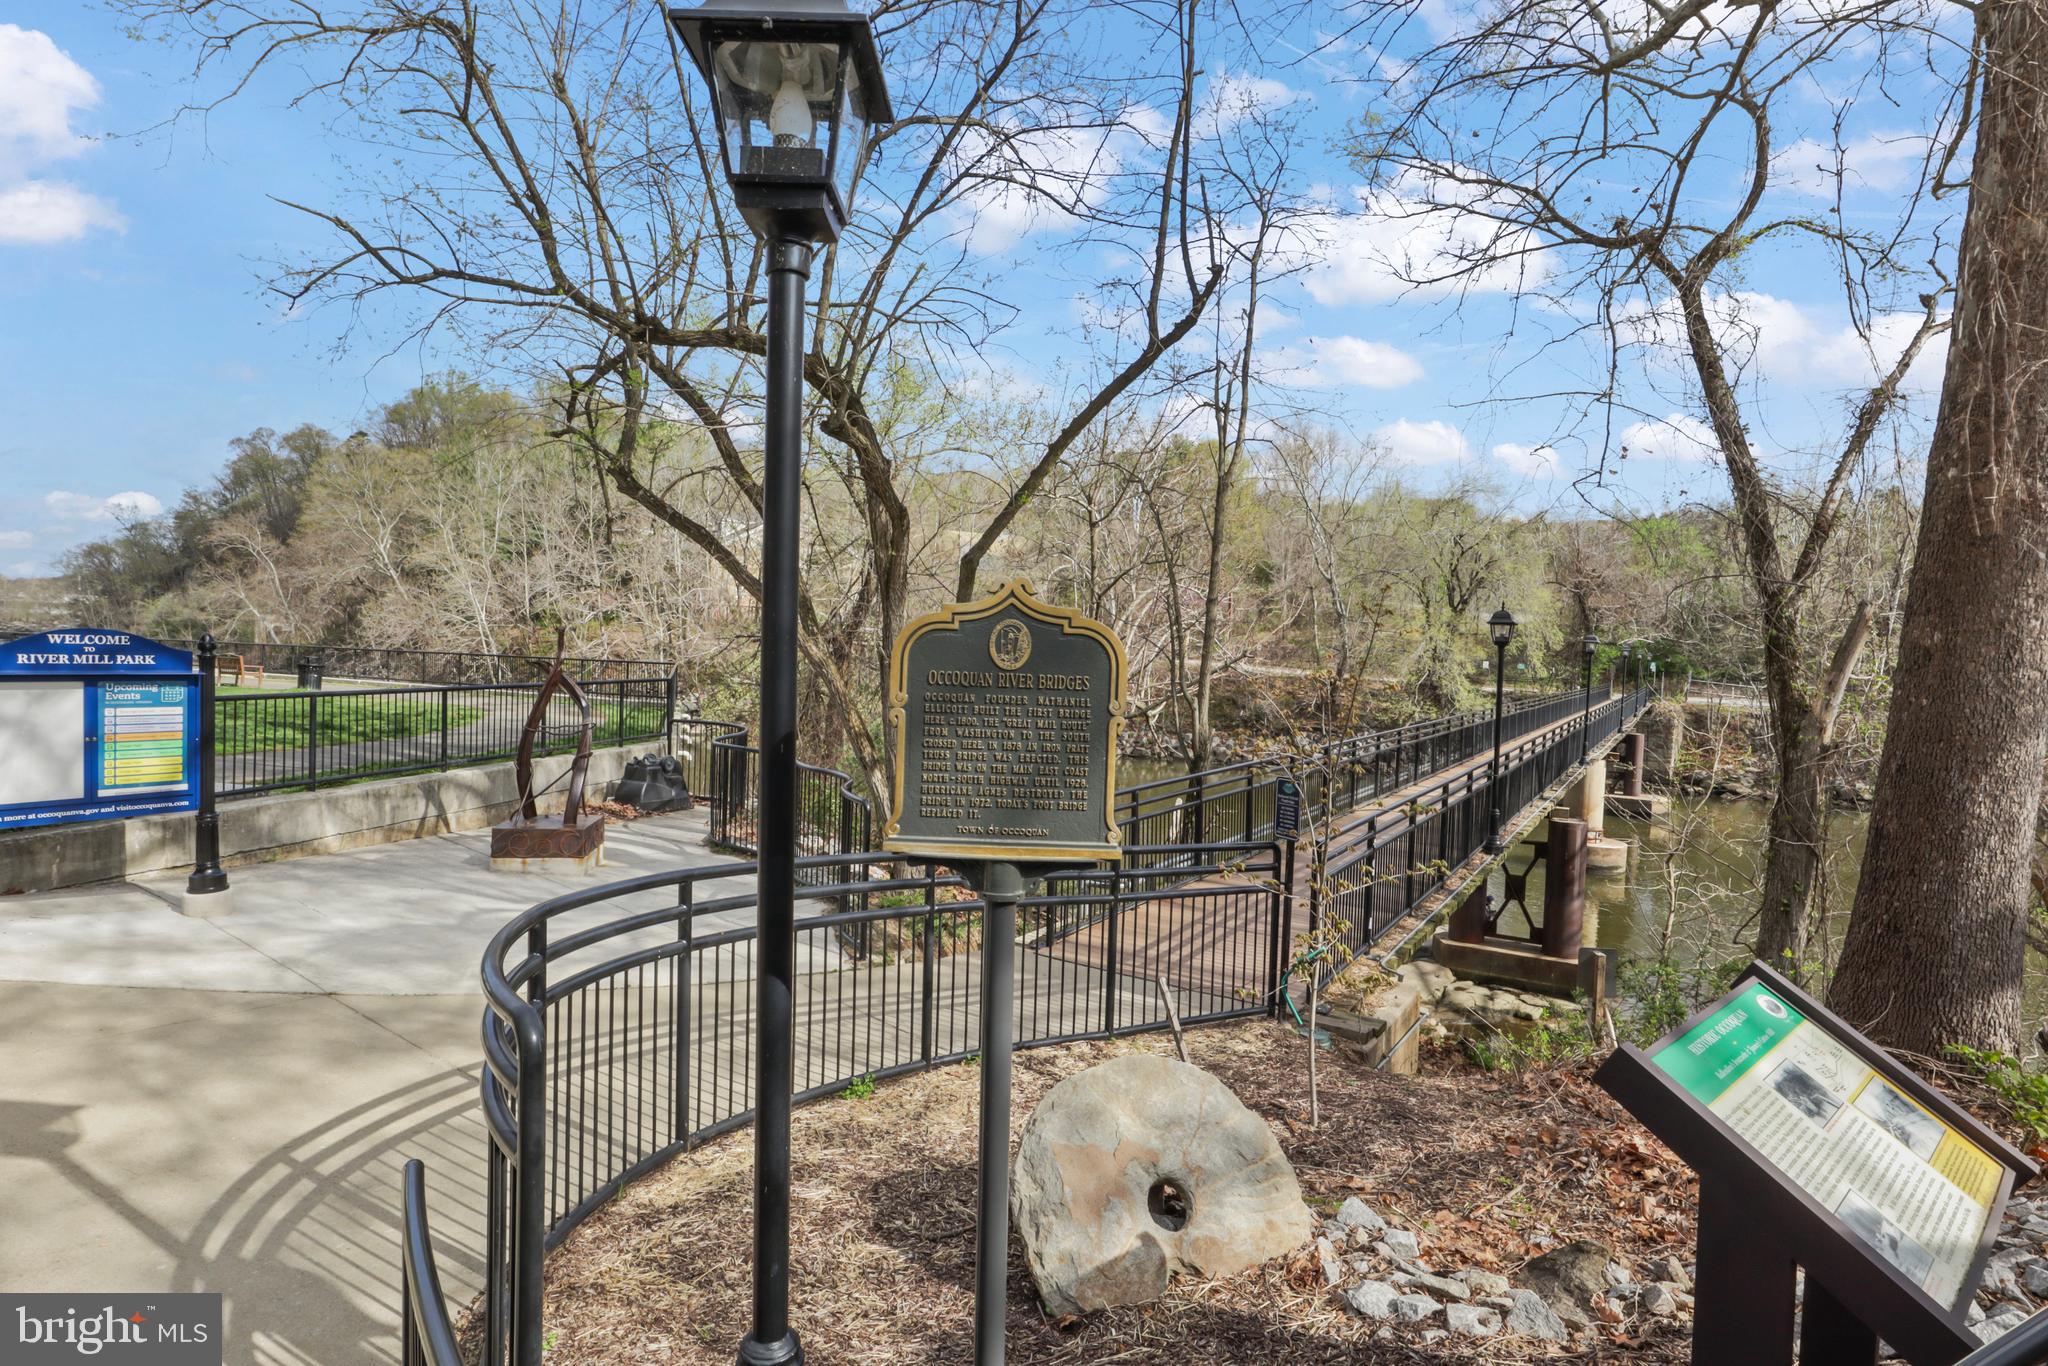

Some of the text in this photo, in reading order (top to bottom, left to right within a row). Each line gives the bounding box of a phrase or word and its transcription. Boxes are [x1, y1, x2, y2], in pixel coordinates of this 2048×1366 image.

[47, 634, 130, 645] WELCOME
[16, 653, 156, 665] RIVER MILL PARK
[928, 670, 1090, 690] OCCOQUAN RIVER BRIDGES
[106, 683, 158, 692] Upcoming
[106, 692, 141, 700] Events
[925, 692, 1092, 707] OCCOQUAN FOUNDER NATHANIEL
[925, 704, 1092, 718] ELLICOTT BUILT THE FIRST BRIDGE
[924, 716, 945, 724] HERE
[958, 716, 979, 726] 1800.
[984, 718, 999, 726] THE
[1036, 720, 1057, 729] MAIL
[924, 727, 1090, 741] FROM WASHINGTON TO THE SOUTH
[923, 738, 957, 748] CROSSED
[962, 740, 984, 749] HERE.
[988, 741, 997, 750] IN
[1026, 742, 1037, 751] AN
[1043, 743, 1061, 752] IRON
[1067, 744, 1090, 753] PRATT
[923, 750, 950, 759] TRUSS
[956, 751, 987, 761] BRIDGE
[994, 752, 1012, 762] WAS
[1069, 755, 1089, 764] THIS
[923, 762, 1089, 776] BRIDGE WAS ON THE MAIN EAST COAST
[990, 776, 1029, 785] HIGHWAY
[1034, 777, 1060, 787] UNTIL
[921, 785, 1088, 799] HURRICANE AGNES DESTROYED THE
[38, 808, 99, 818] occoquanva.gov
[116, 800, 189, 812] visitoccoquanva.com
[921, 796, 1088, 811] BRIDGE IN 1972. TODAY'S FOOT BRIDGE
[921, 808, 981, 819] REPLACED IT.
[956, 826, 984, 834] TOWN
[1002, 827, 1049, 836] OCCOQUAN
[1688, 1029, 1721, 1056] HISTORIC
[1714, 1008, 1748, 1035] OCCOQUAN
